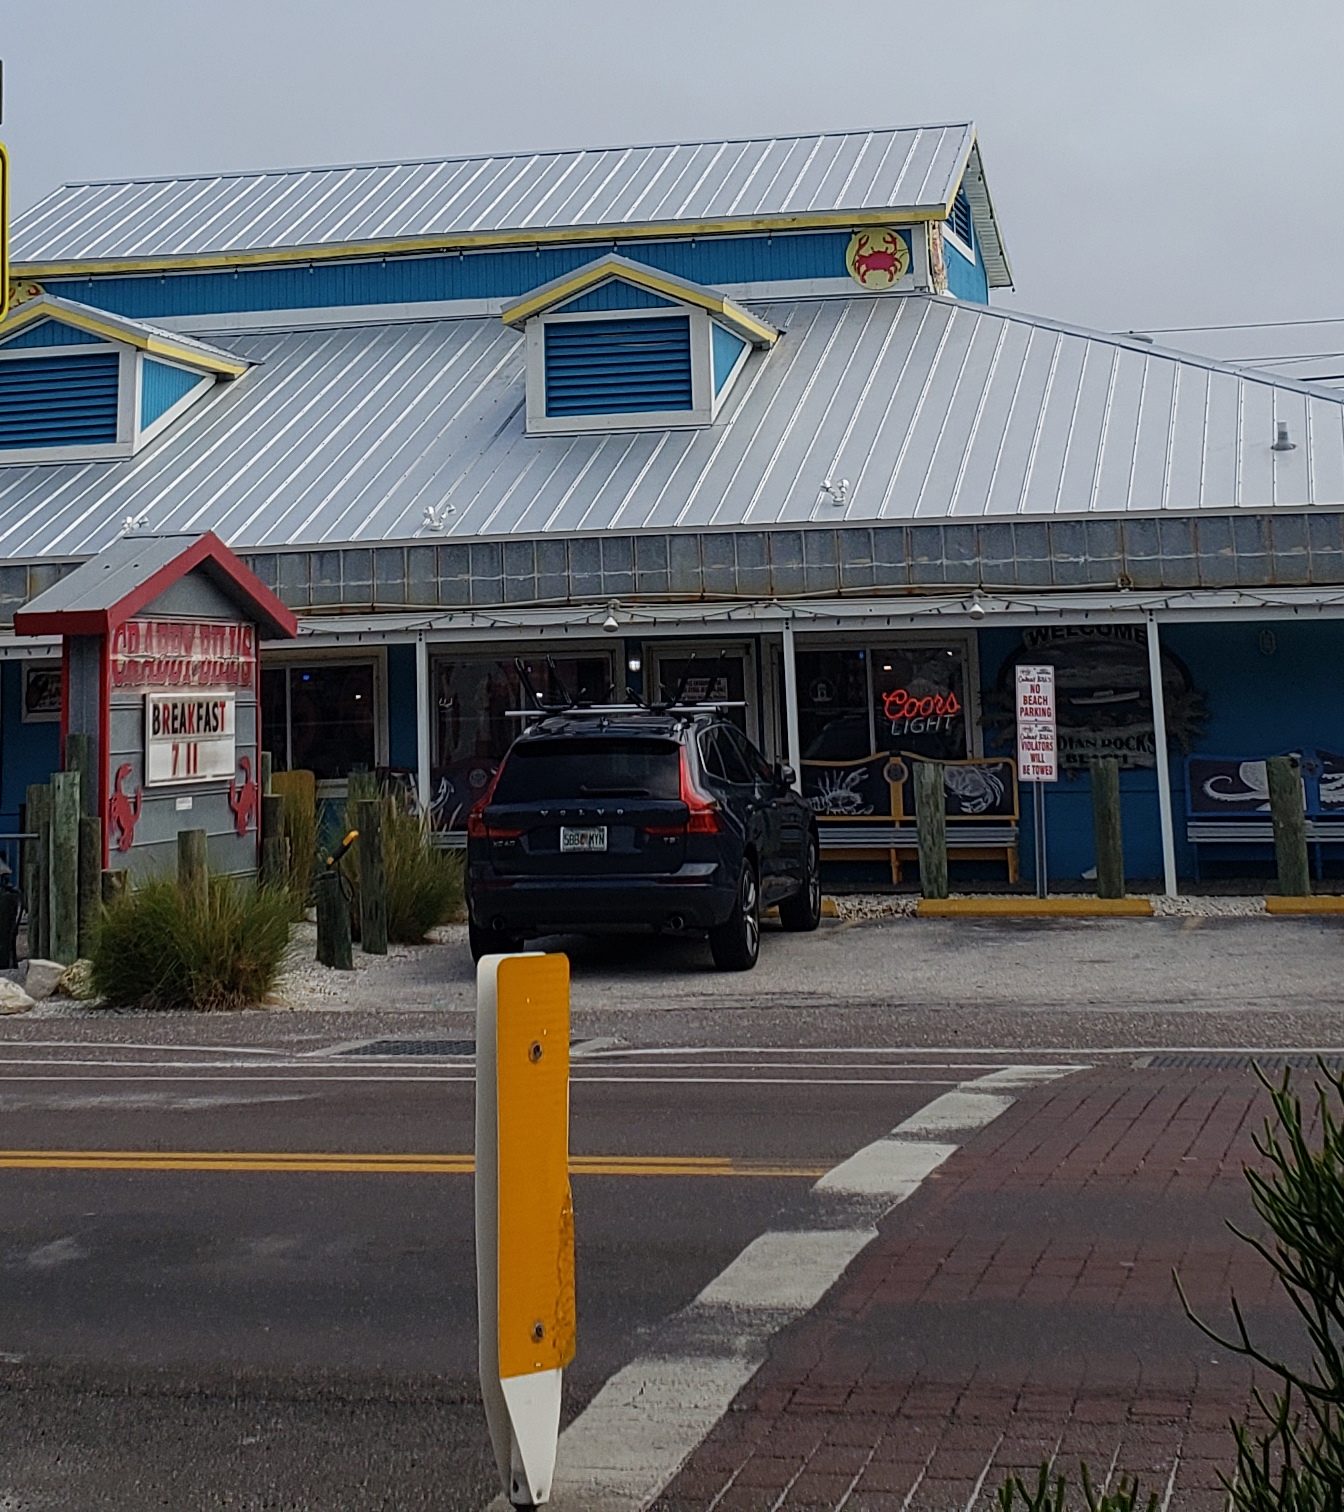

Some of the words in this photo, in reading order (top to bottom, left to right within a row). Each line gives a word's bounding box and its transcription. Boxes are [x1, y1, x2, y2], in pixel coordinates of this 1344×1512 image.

[1028, 624, 1147, 646] WELCOME
[1029, 684, 1040, 694] NO
[882, 689, 961, 720] Coors
[1022, 695, 1048, 705] BEACH
[1019, 707, 1052, 717] PARKING
[152, 701, 226, 736] BREAKFAST
[891, 714, 955, 735] LIGHT
[1021, 741, 1054, 751] VIOLATORS
[171, 743, 180, 776] 7
[1030, 753, 1045, 763] WILL
[1022, 765, 1031, 775] BE
[1032, 765, 1053, 775] TOWED
[540, 809, 624, 817] VOLVO
